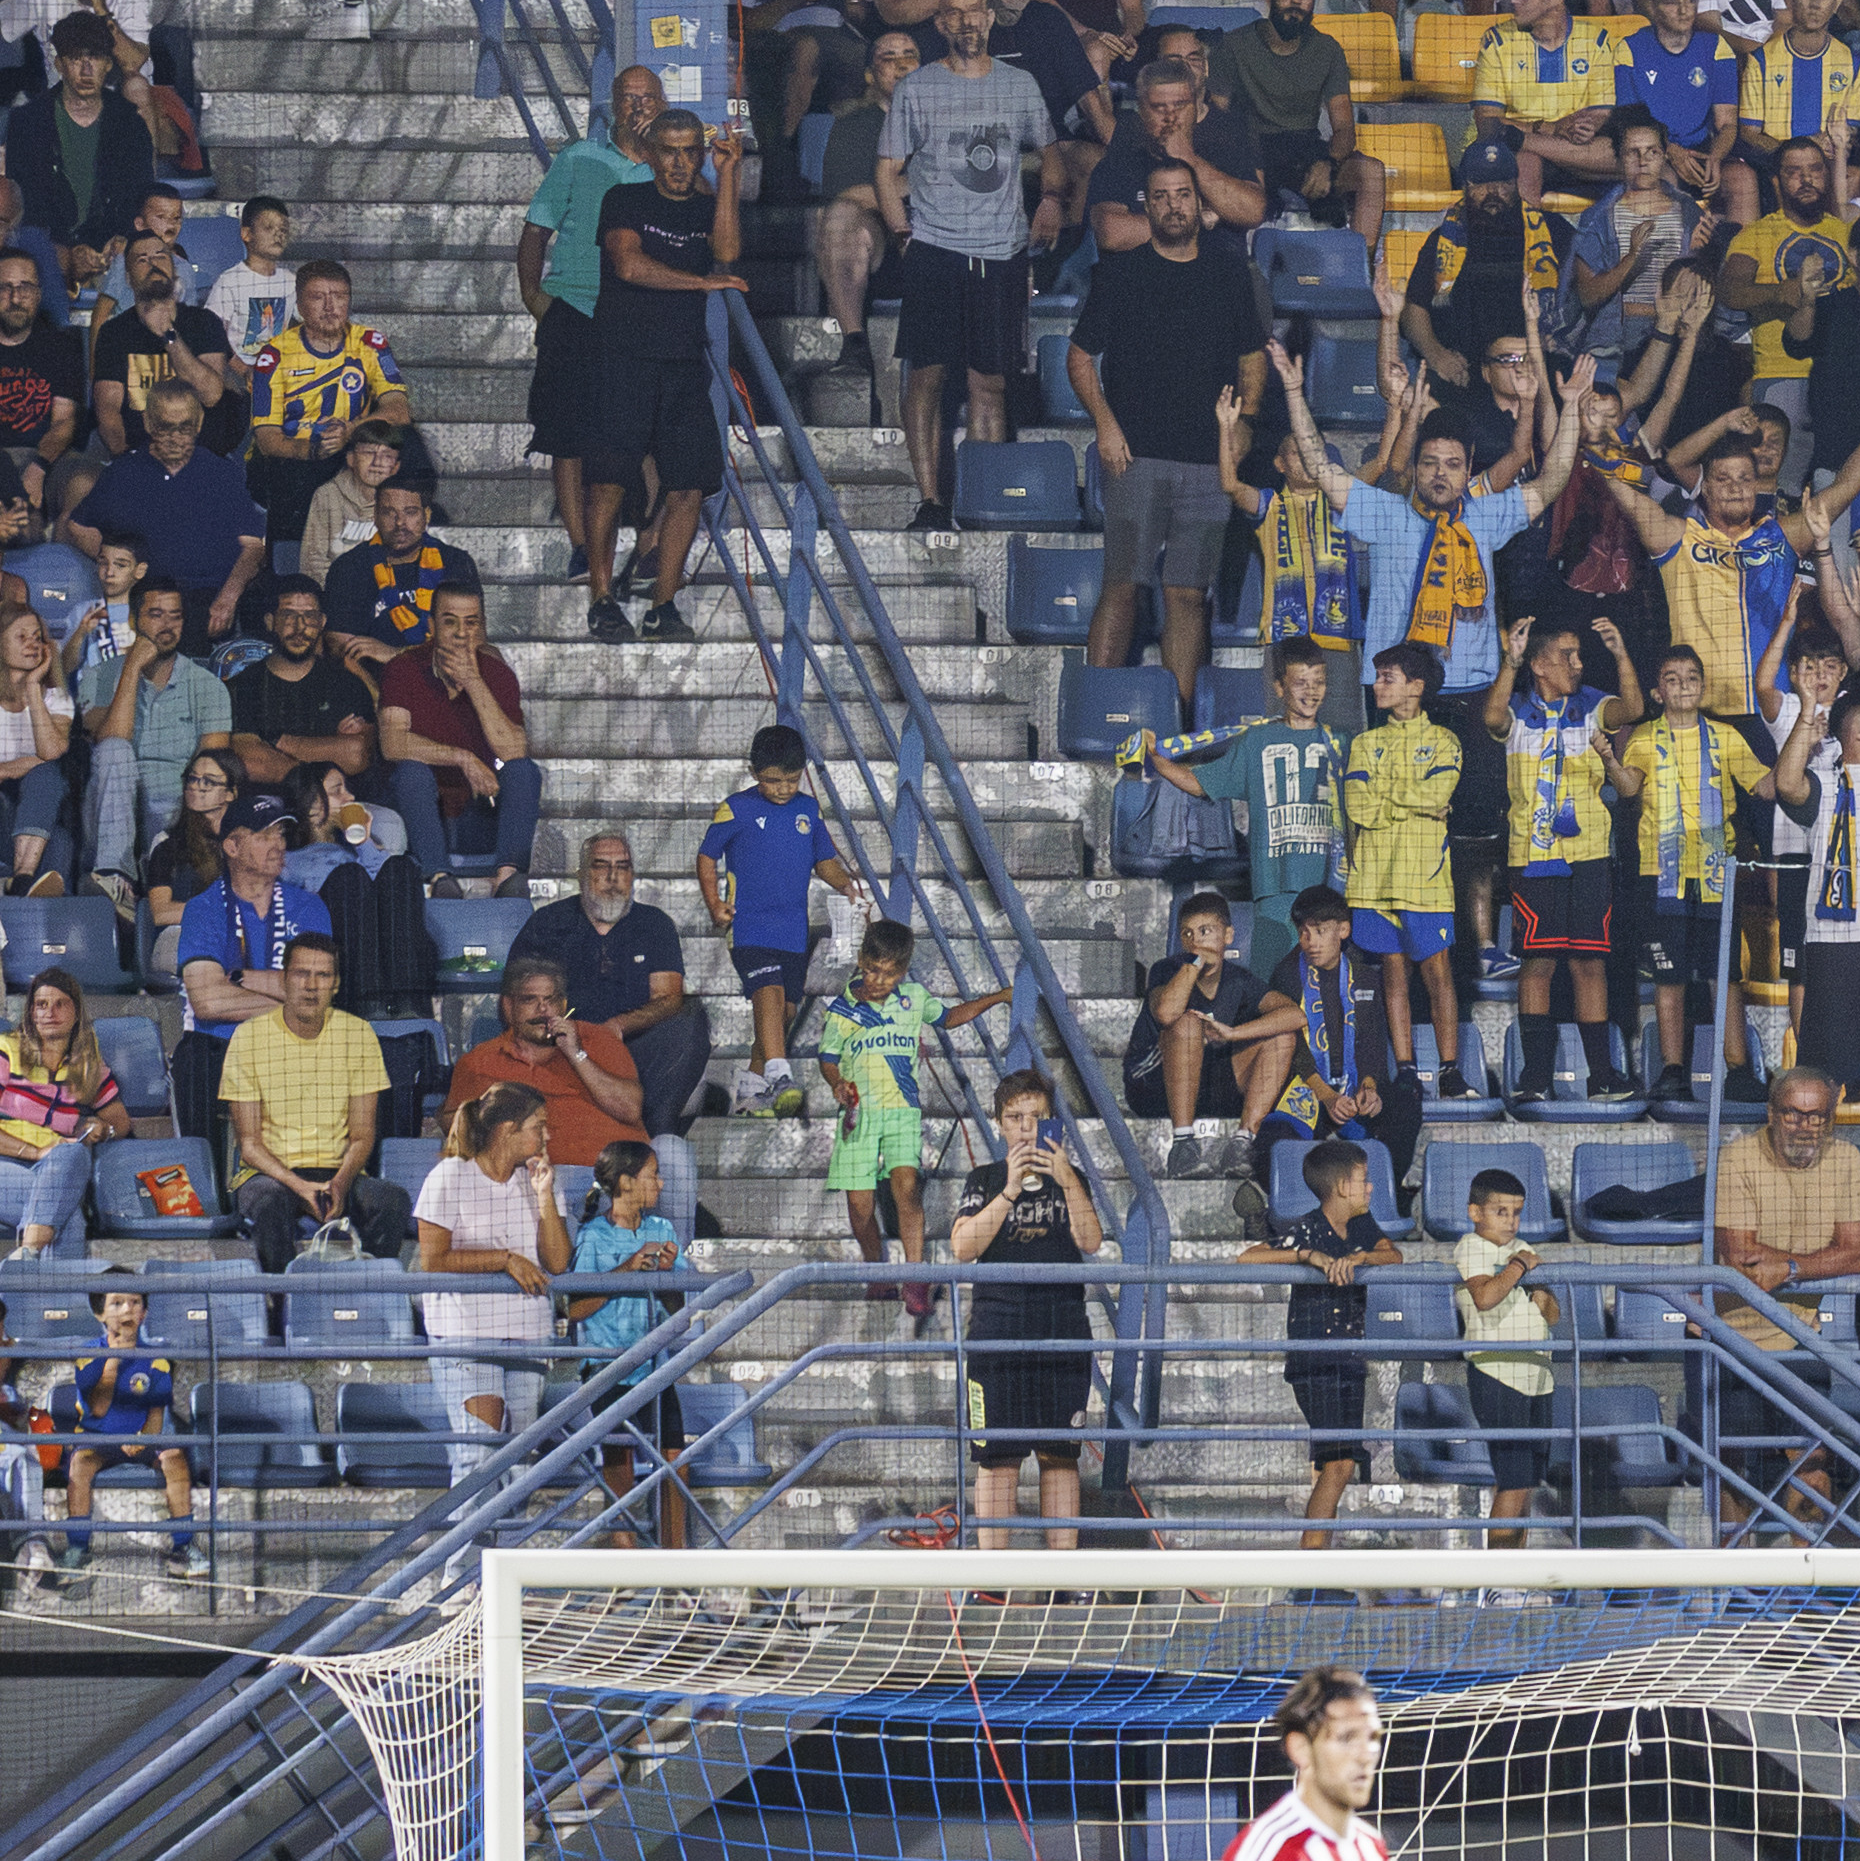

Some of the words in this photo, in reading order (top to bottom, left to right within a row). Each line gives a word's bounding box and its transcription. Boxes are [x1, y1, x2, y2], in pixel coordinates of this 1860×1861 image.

[731, 101, 748, 115] 13
[880, 431, 897, 445] 10
[1037, 766, 1056, 779] 07
[1267, 806, 1335, 832] CALIFORNI
[1198, 1122, 1217, 1136] 04
[687, 1242, 705, 1257] 03
[738, 1365, 756, 1378] 02
[795, 1492, 812, 1507] 01
[1378, 1489, 1394, 1502] 01
